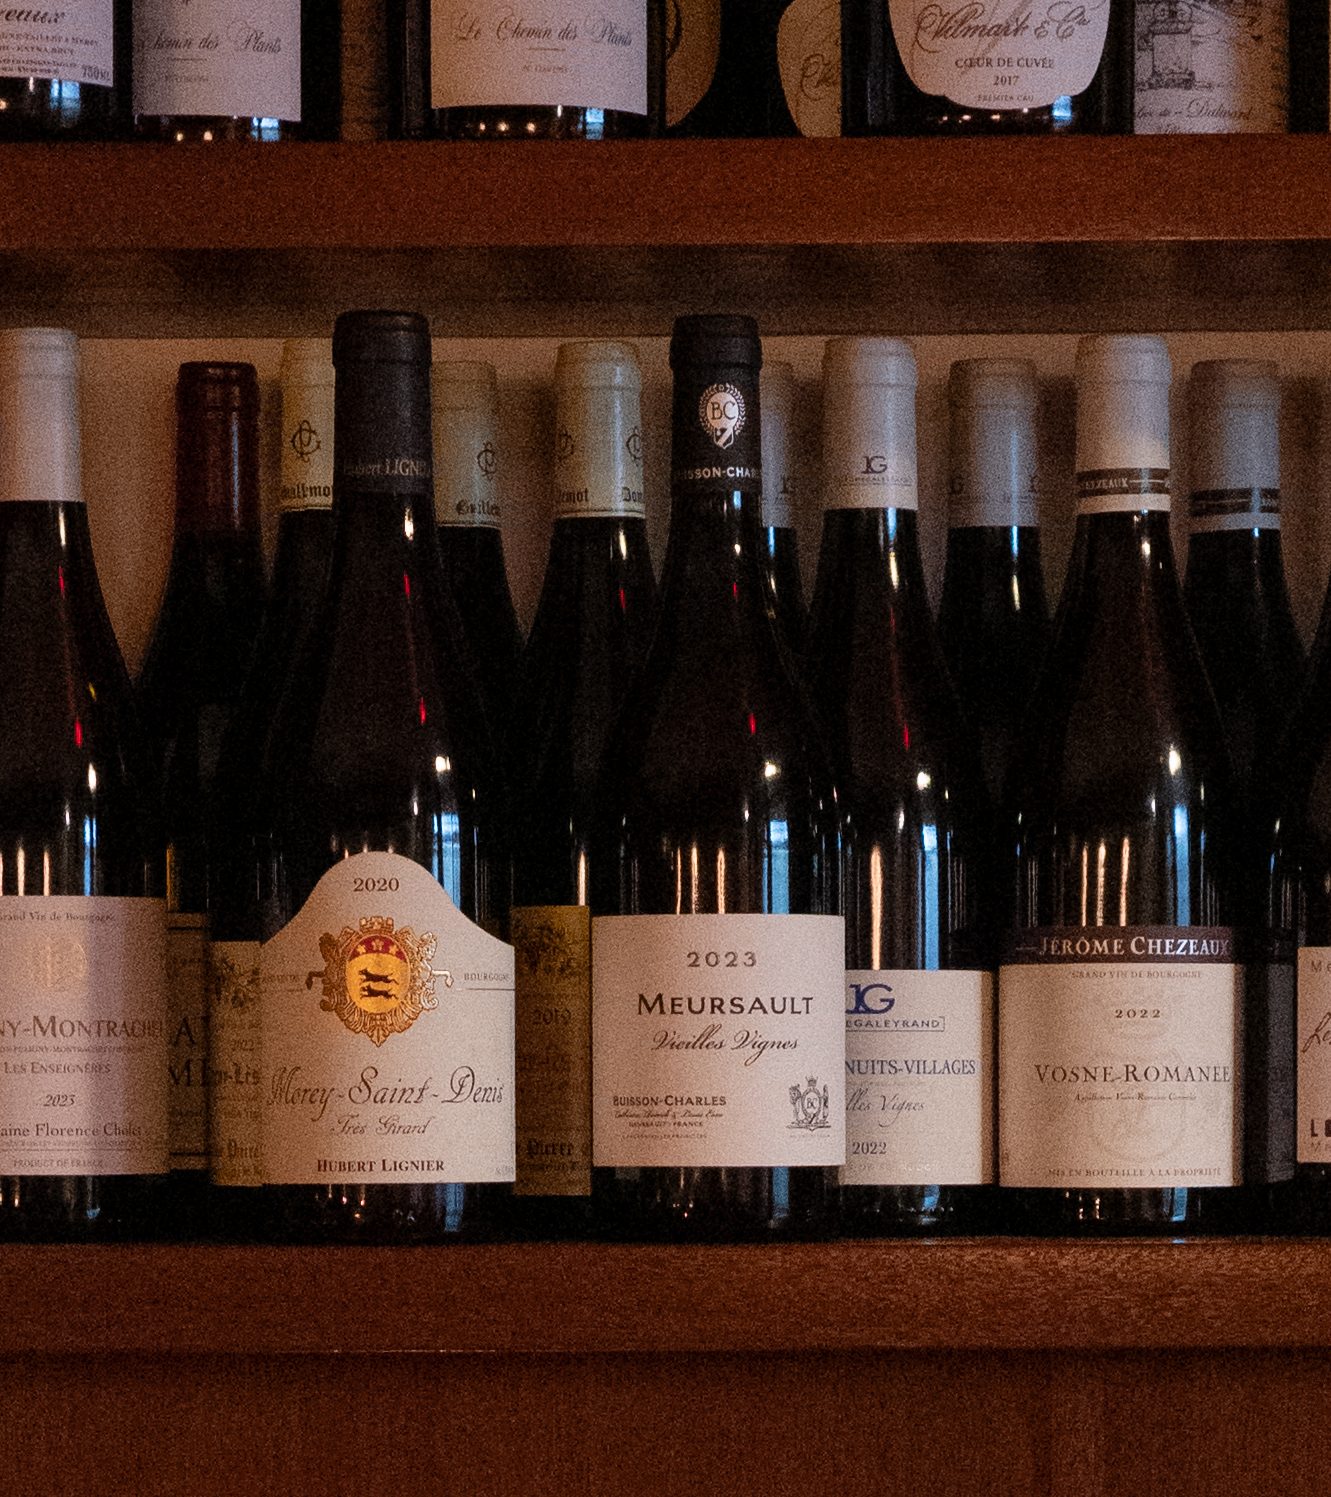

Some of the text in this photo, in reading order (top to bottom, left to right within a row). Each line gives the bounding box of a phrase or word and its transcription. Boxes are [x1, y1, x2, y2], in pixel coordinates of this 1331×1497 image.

[496, 5, 552, 41] Chemin
[558, 23, 577, 41] des
[584, 10, 632, 46] Plants
[992, 75, 1020, 87] 2017
[353, 877, 399, 892] 2020
[1039, 936, 1229, 956] JÉRÔME CHEZEAUX
[686, 951, 757, 968] 2023
[637, 993, 814, 1015] MEURSAULT
[1115, 1009, 1161, 1019] 2022
[651, 1023, 798, 1067] Vieilles Vignes
[845, 1059, 976, 1076] NUITS-VILLAGES
[613, 1096, 727, 1107] BUISSON-CHARLES
[34, 1123, 99, 1137] Florence
[852, 1141, 887, 1155] 2022
[317, 1159, 445, 1173] HUBERT LIGNIER
